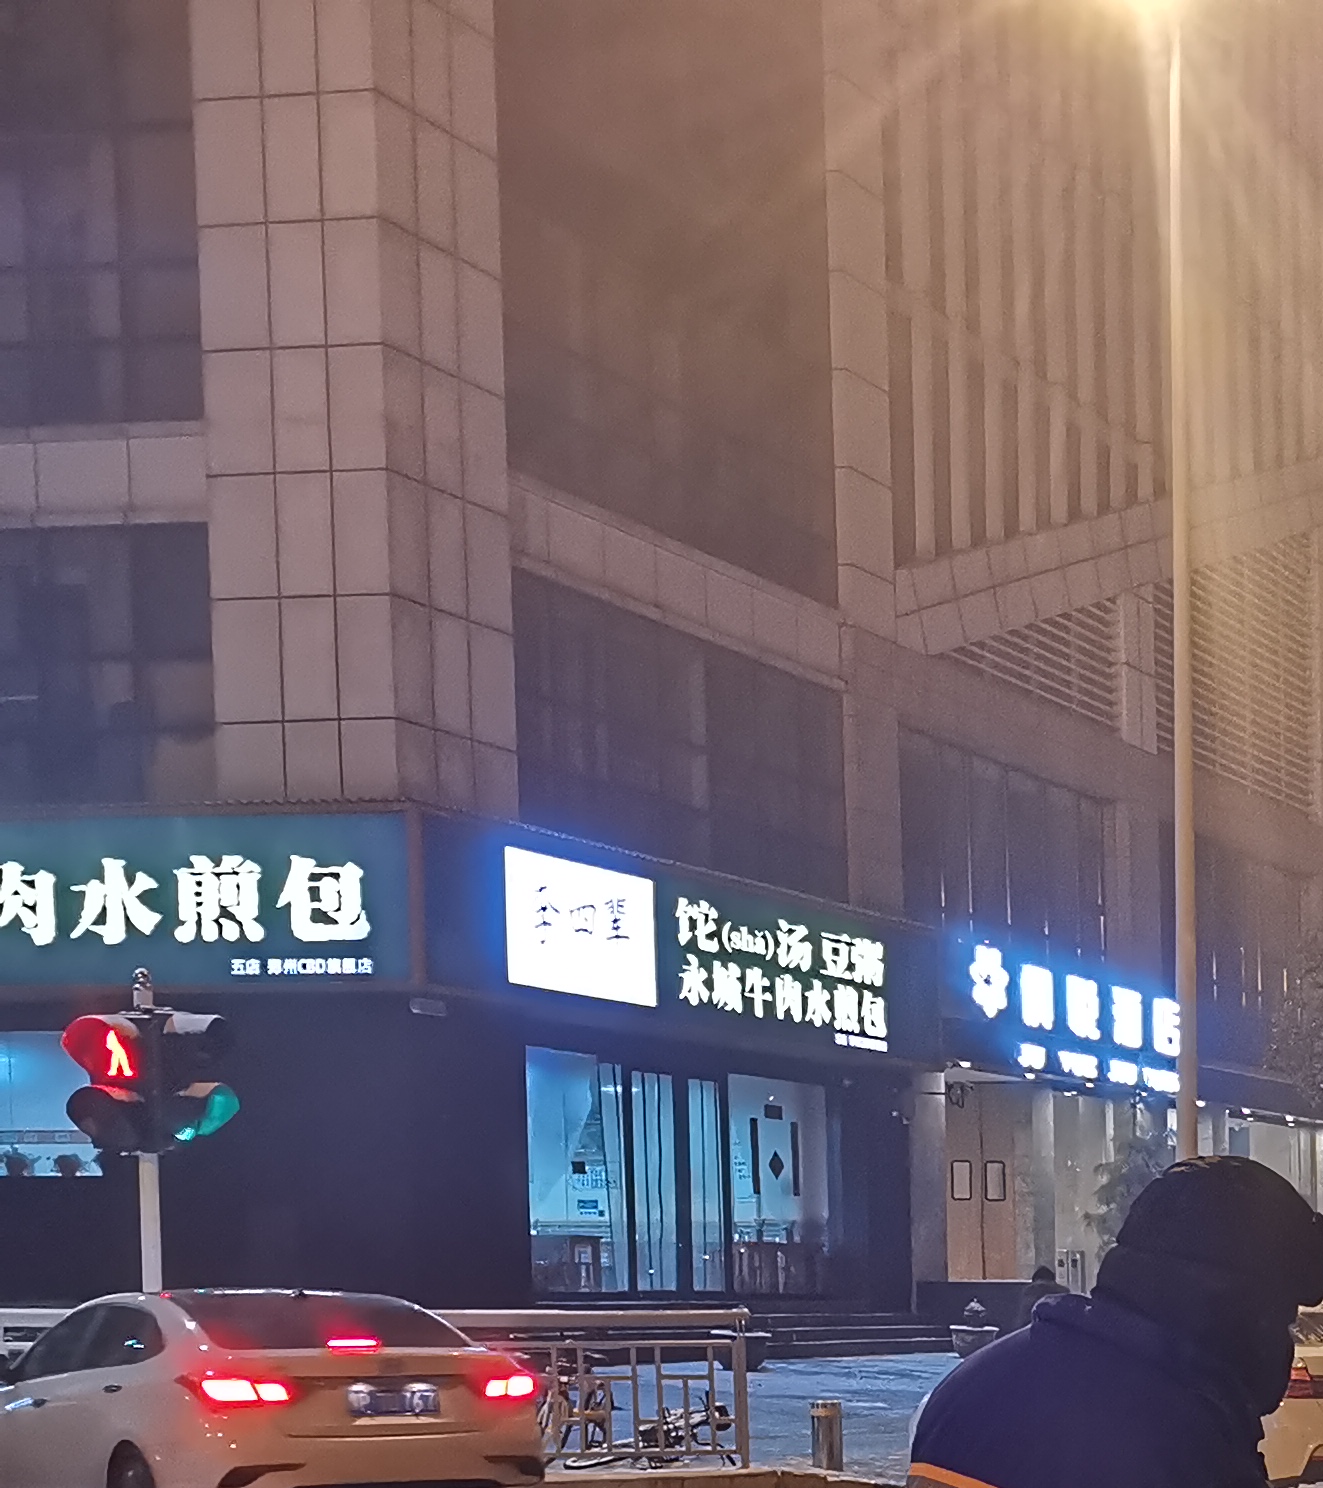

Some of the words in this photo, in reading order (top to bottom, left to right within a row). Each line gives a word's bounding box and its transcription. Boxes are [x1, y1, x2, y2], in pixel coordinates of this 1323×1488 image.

[0, 854, 373, 946] 肉水煎包
[230, 957, 261, 976] 五店
[678, 953, 887, 1038] 永城牛肉水煎包
